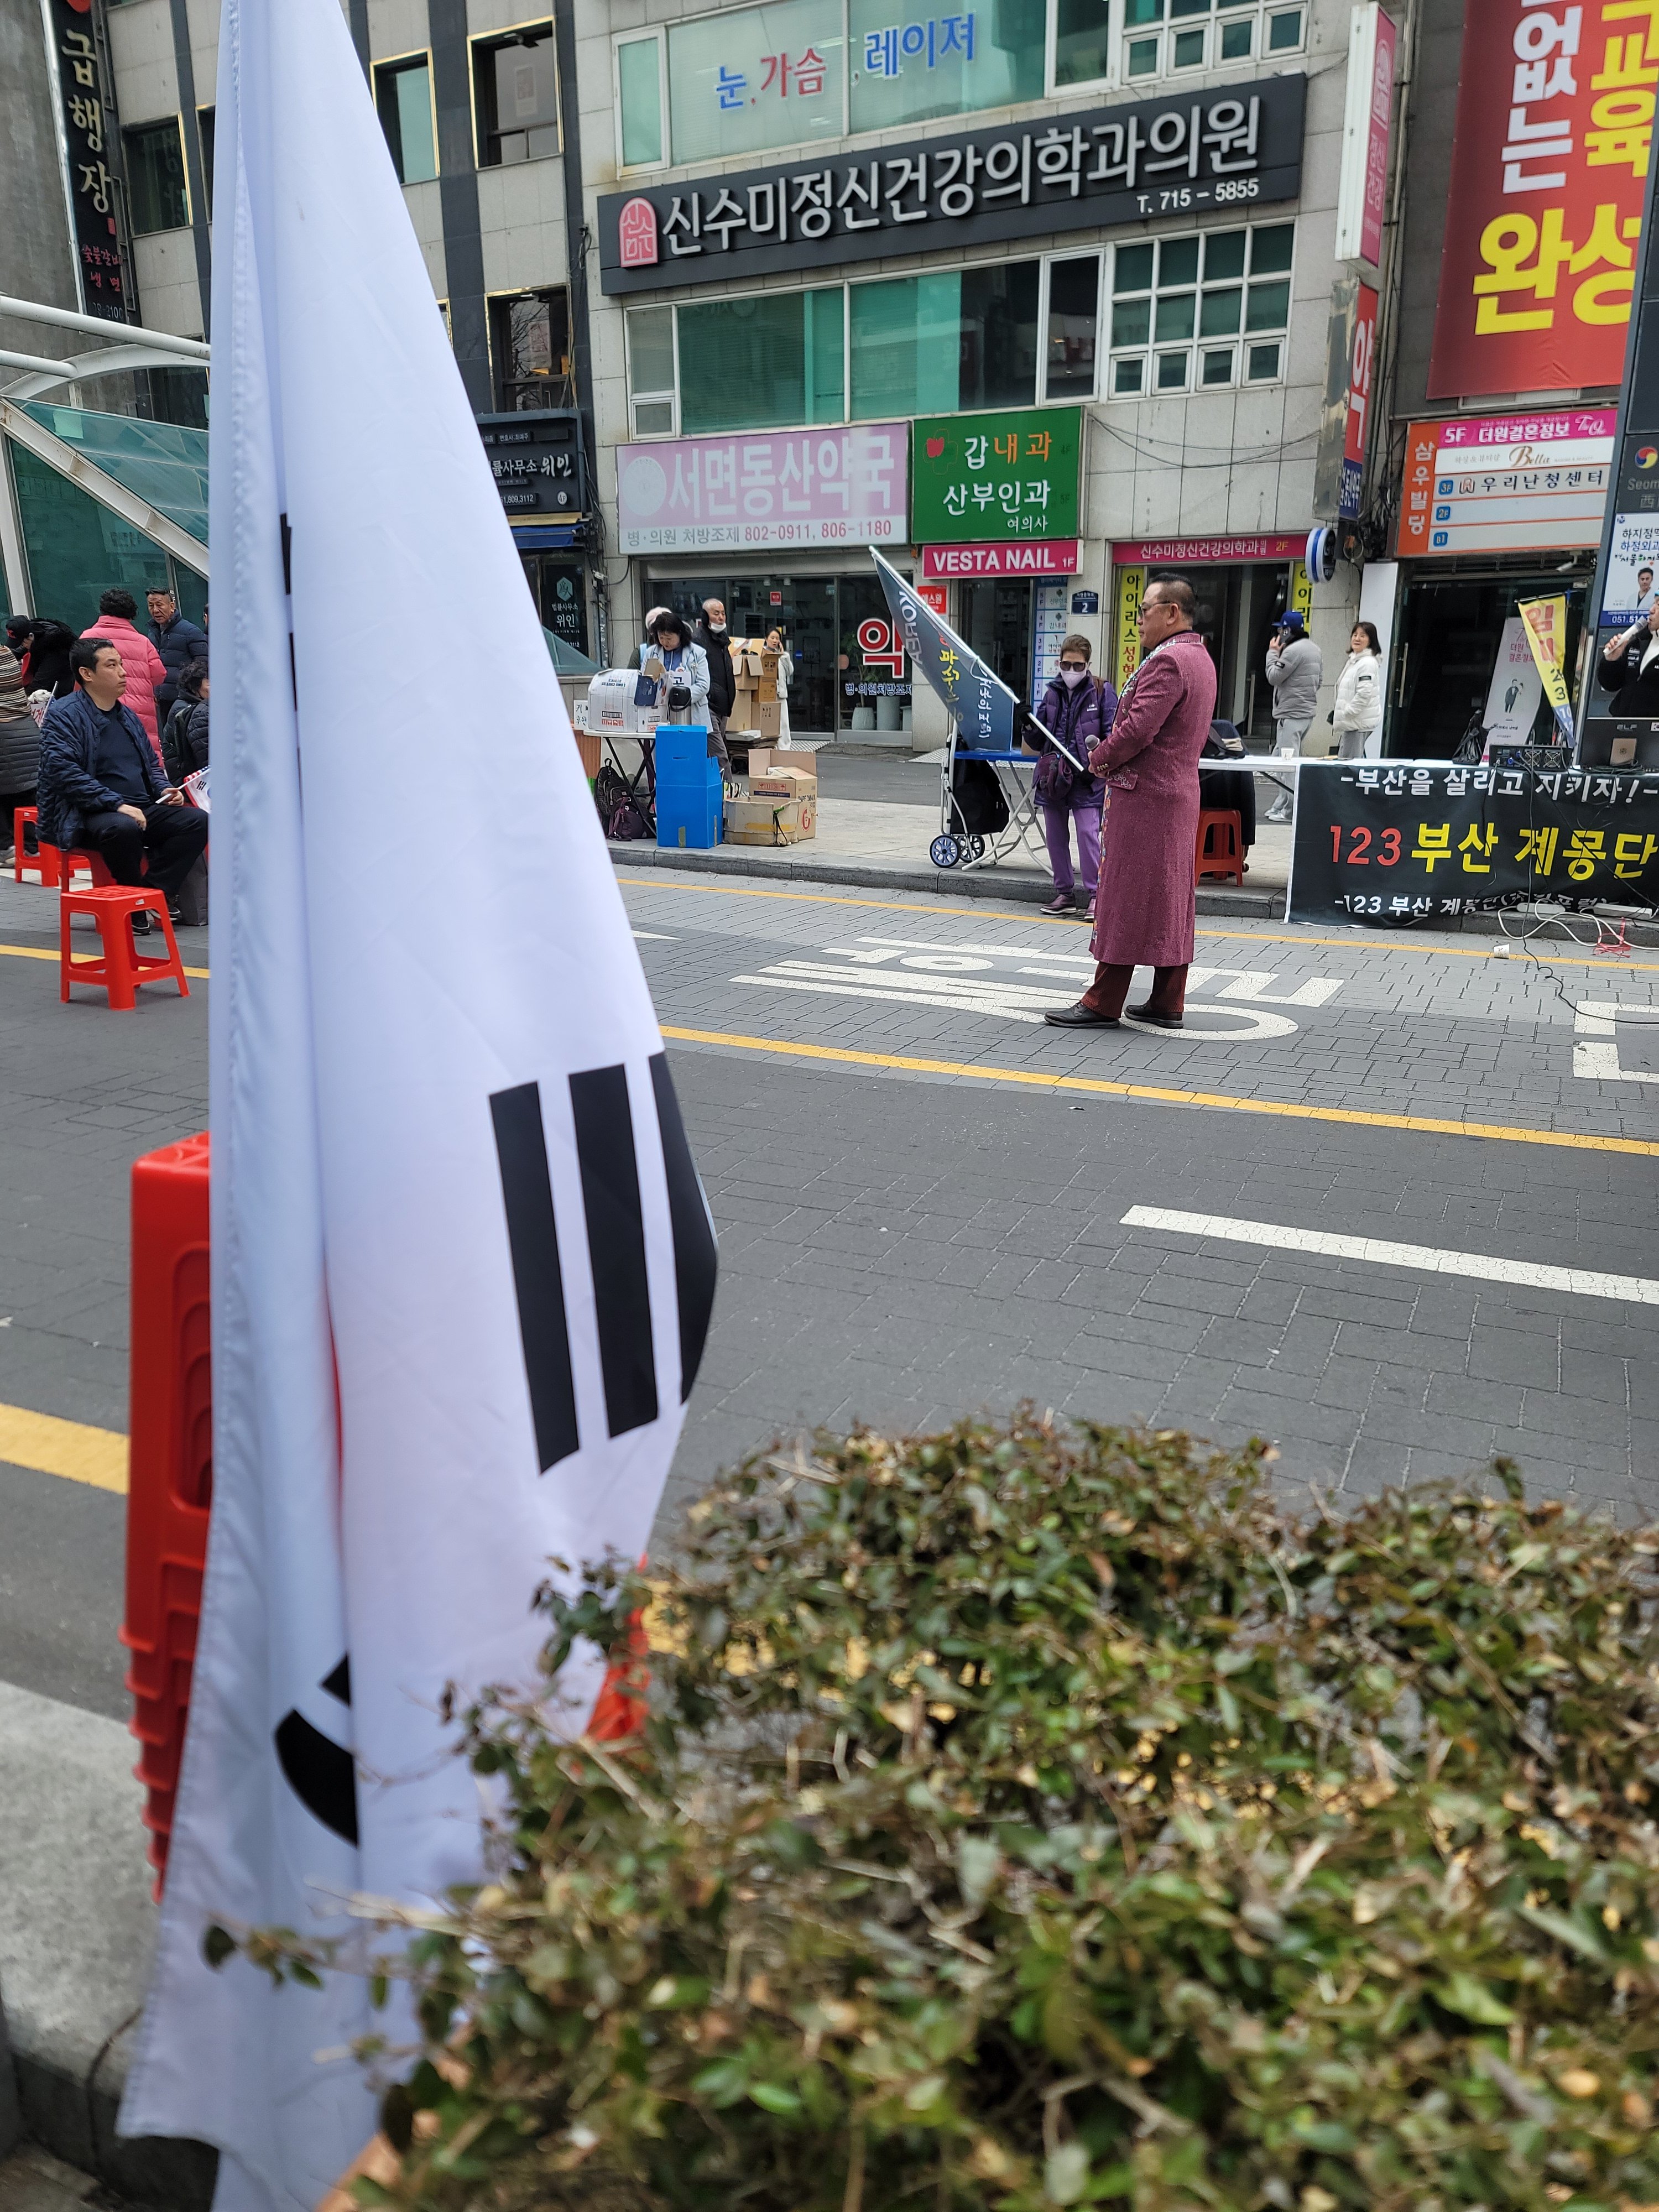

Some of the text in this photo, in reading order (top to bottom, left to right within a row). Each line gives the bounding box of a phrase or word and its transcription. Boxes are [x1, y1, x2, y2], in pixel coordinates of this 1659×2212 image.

[662, 95, 1260, 256] 신수미정신건강의학과의원
[489, 458, 538, 477] 률사무소
[668, 434, 895, 519] 서면동산약국
[1408, 441, 1435, 536] 삼우빌딩
[1480, 470, 1603, 493] 우리난청센터
[942, 478, 1051, 516] 산부인과
[682, 525, 740, 546] 처방조제
[1006, 514, 1048, 534] 여의사
[932, 547, 1075, 572] VESTA NAIL 1F
[1140, 539, 1259, 560] 신수미정신건강의학과
[1082, 602, 1088, 613] 2
[1124, 575, 1141, 643] 아이리스
[556, 613, 575, 628] 위인
[1443, 769, 1524, 797] 살리고
[1329, 821, 1659, 881] 123 부산 계몽단
[1388, 896, 1433, 917] 부산
